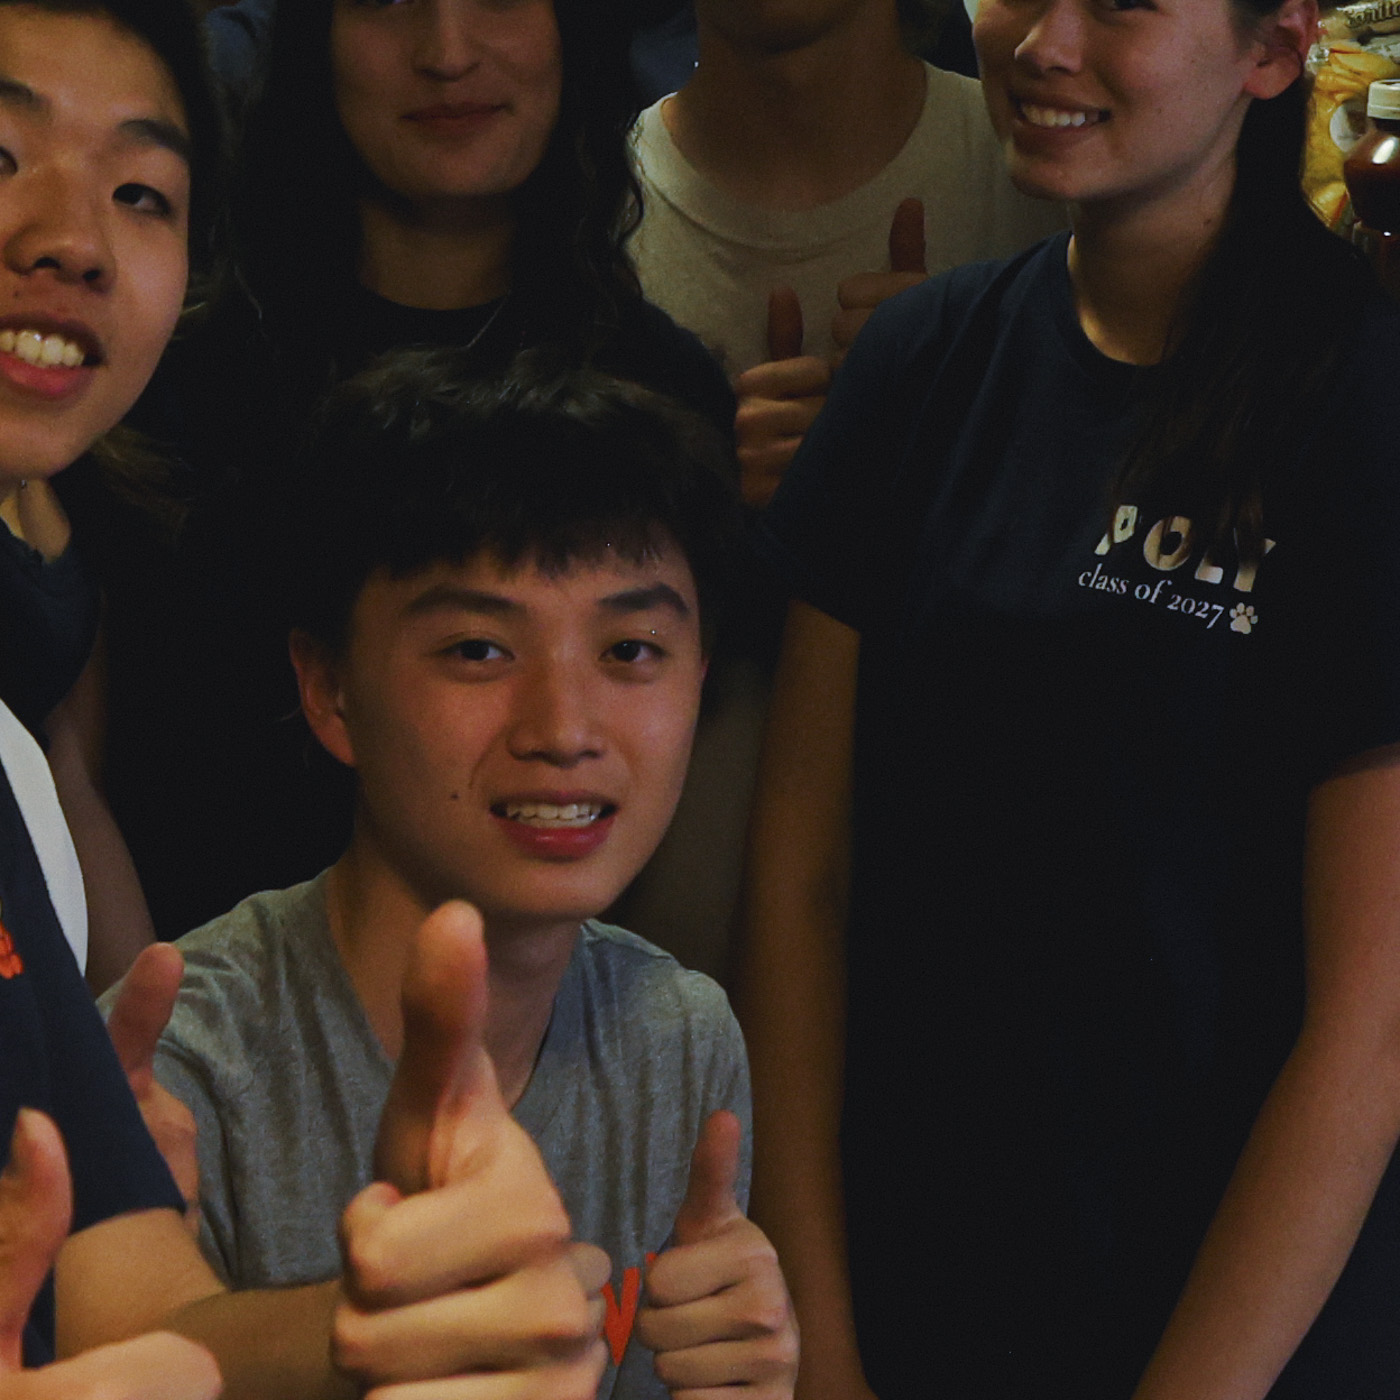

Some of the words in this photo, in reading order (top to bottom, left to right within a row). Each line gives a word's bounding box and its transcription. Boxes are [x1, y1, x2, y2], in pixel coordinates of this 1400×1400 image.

[1078, 563, 1130, 595] class
[1134, 579, 1173, 604] of
[1167, 593, 1226, 629] 2027
